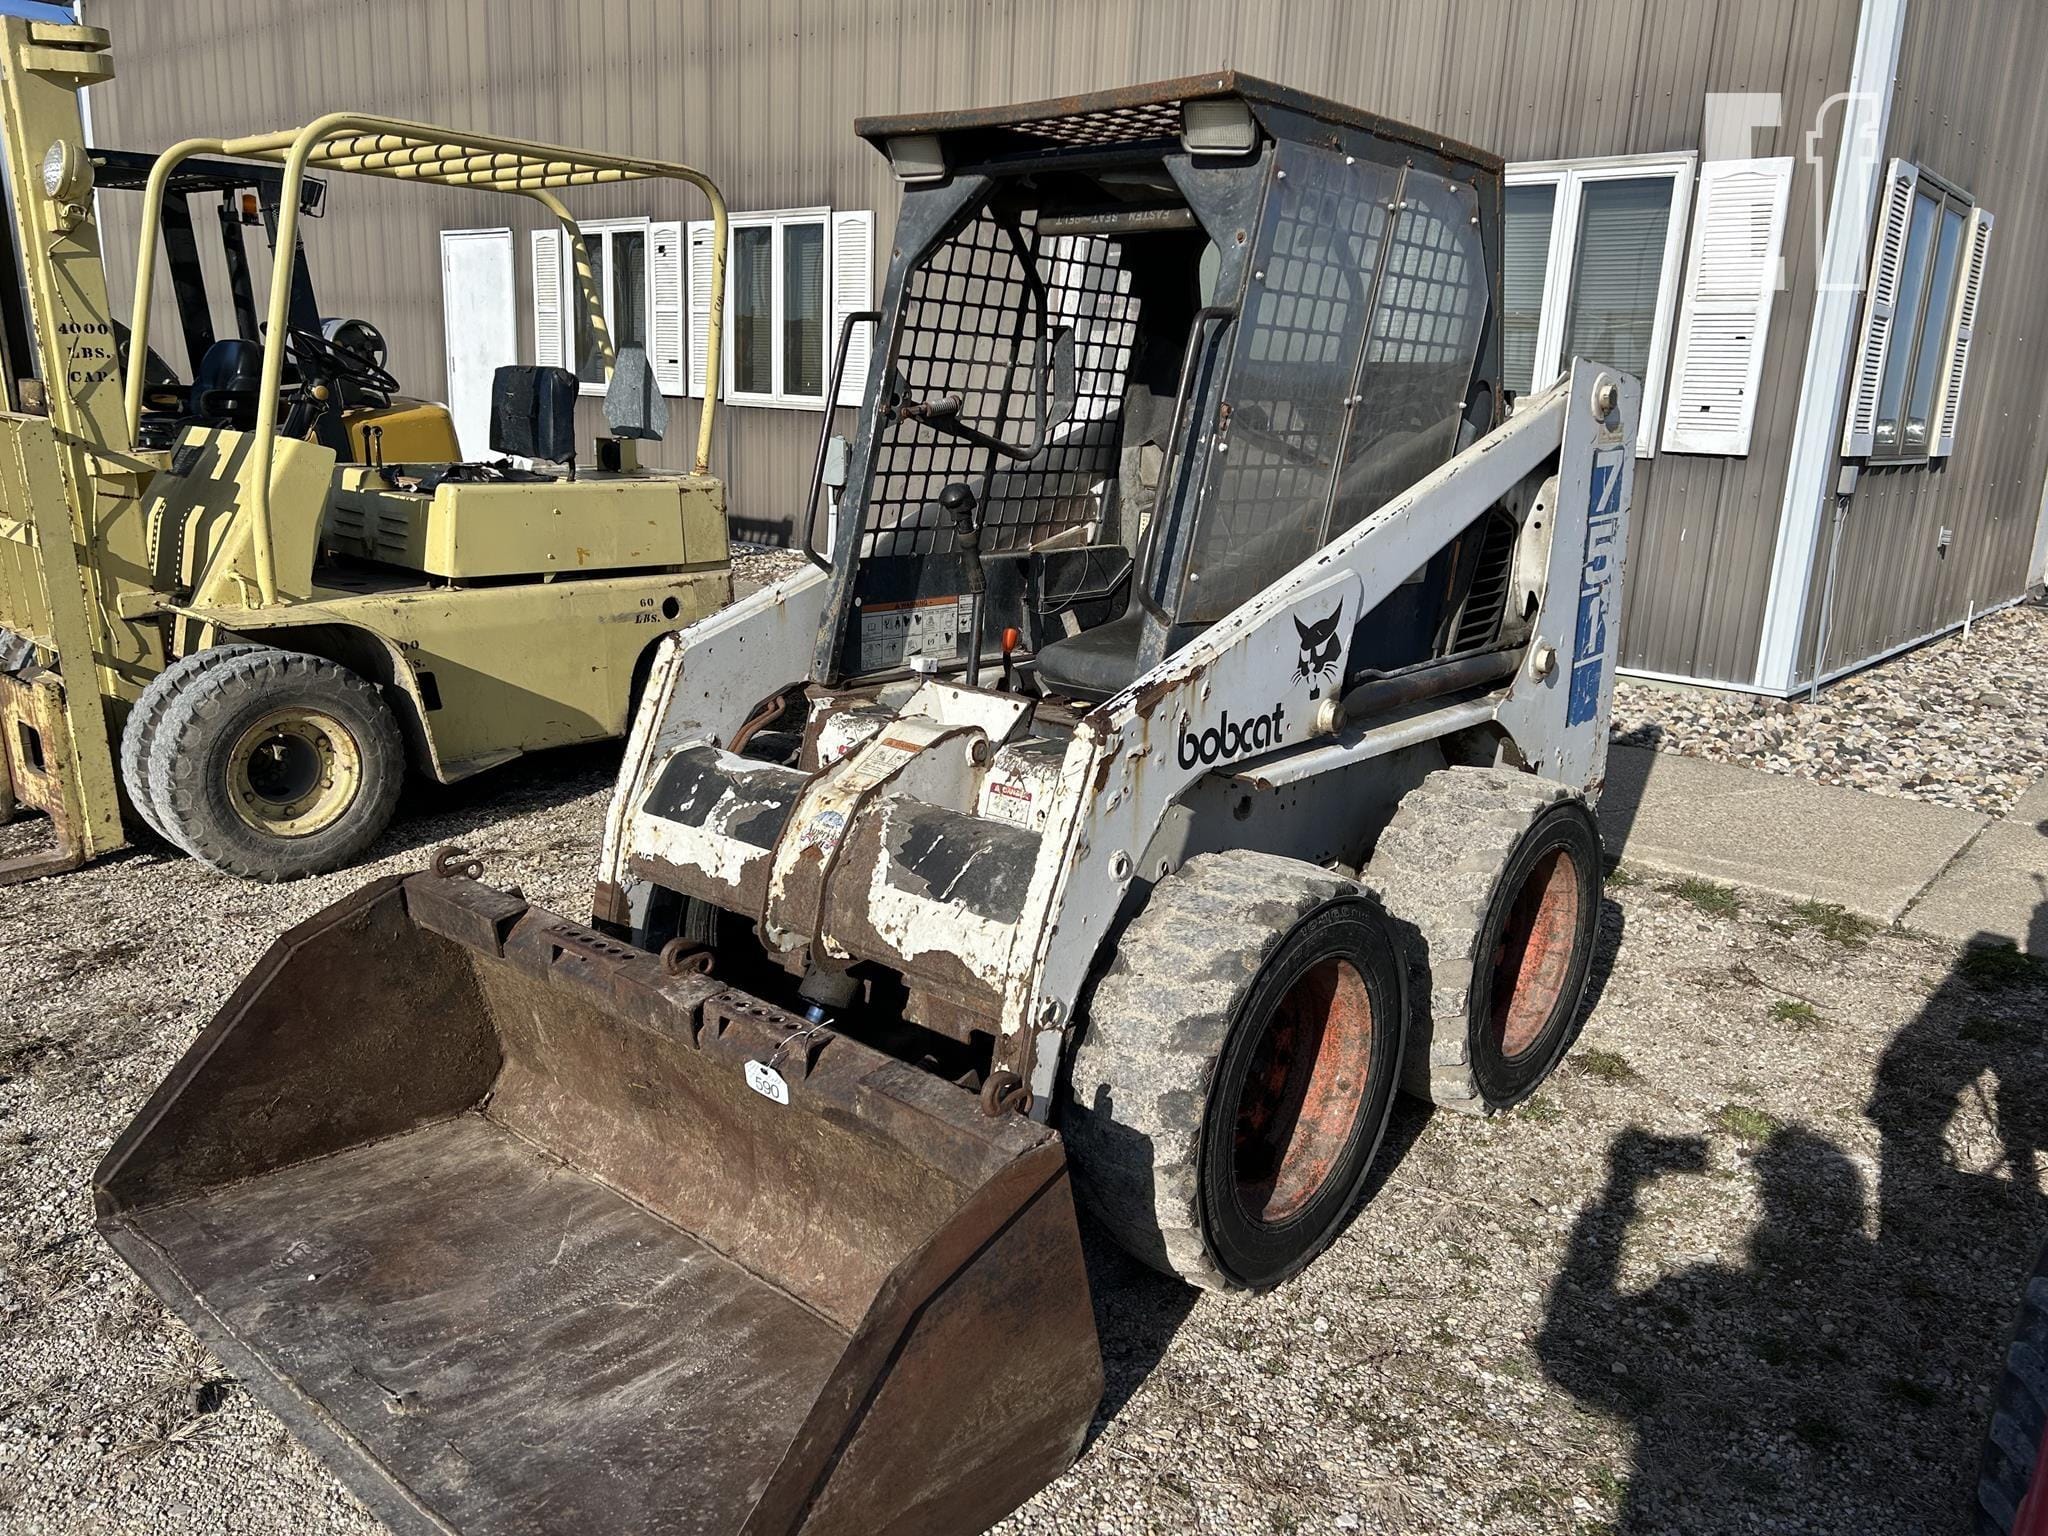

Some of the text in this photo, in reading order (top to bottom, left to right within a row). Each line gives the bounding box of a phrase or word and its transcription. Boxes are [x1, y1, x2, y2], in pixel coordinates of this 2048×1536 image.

[58, 323, 108, 335] 4000
[67, 346, 111, 359] LBS.
[70, 371, 115, 383] CAP.
[639, 598, 654, 607] 60
[634, 613, 661, 624] LBS.
[1177, 702, 1285, 771] bobcat
[755, 1076, 780, 1099] 590
